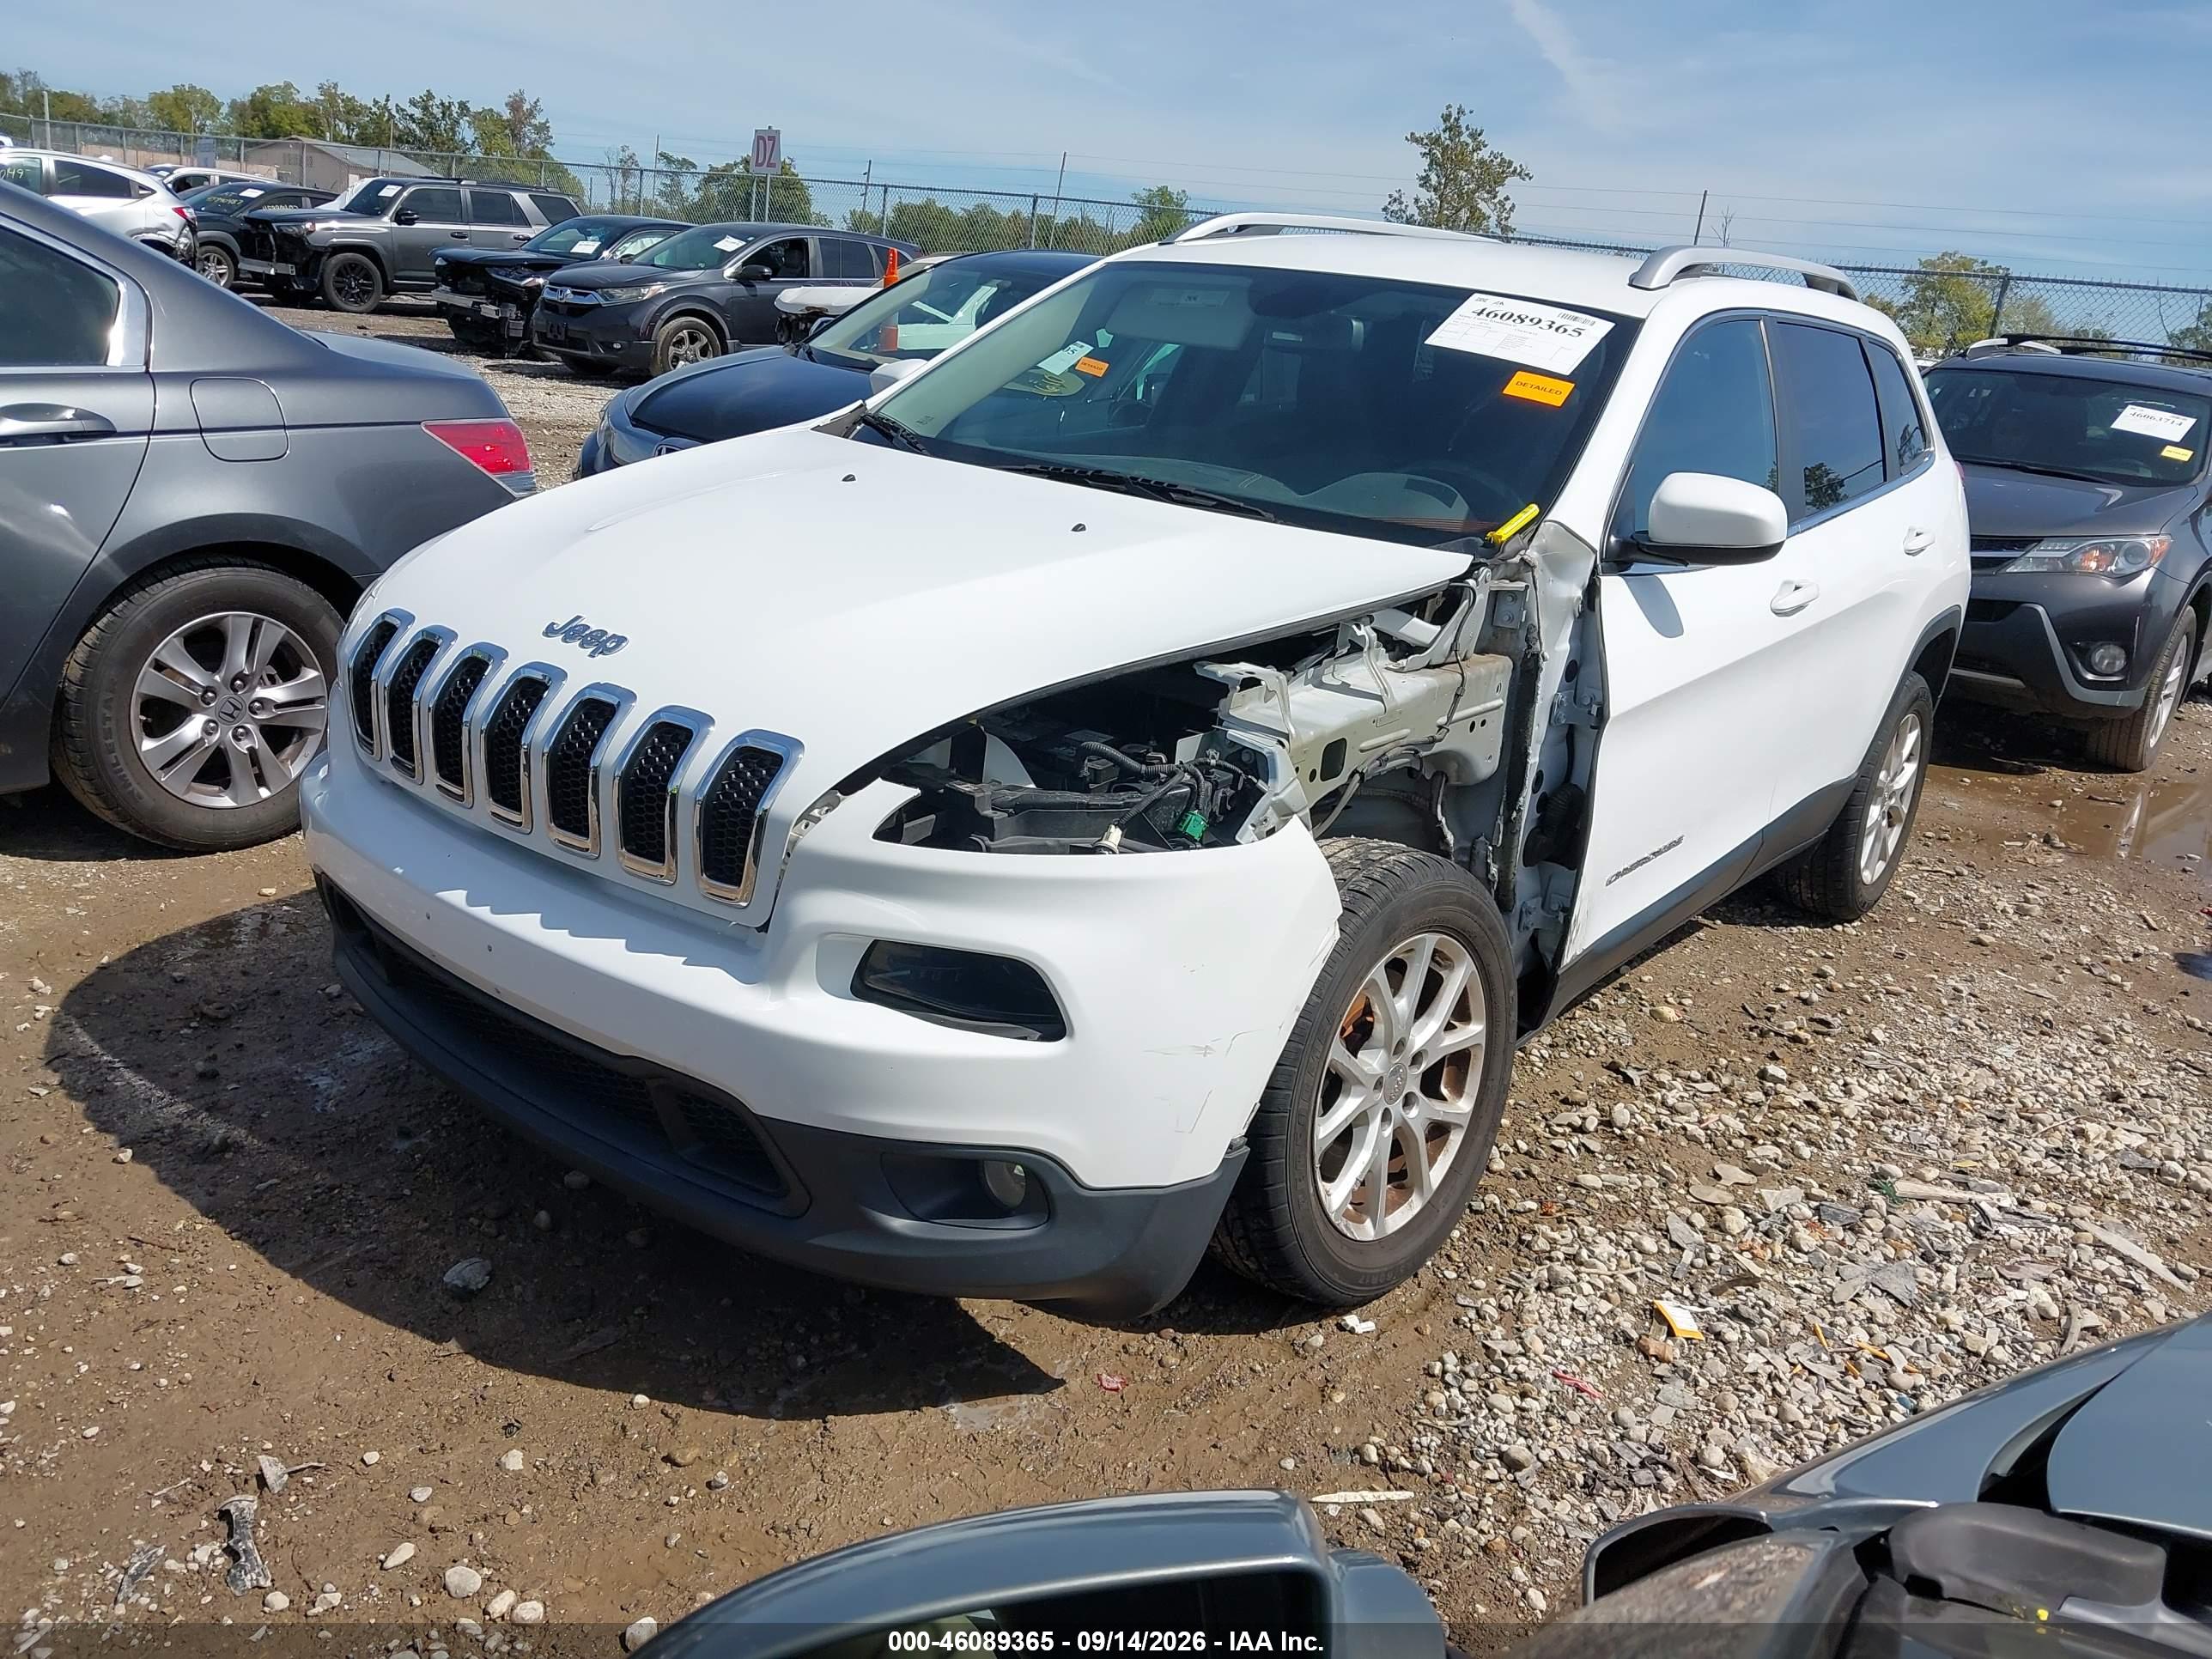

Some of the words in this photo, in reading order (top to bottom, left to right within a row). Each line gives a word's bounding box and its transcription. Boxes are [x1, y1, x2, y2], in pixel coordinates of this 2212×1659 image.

[755, 135, 777, 168] DZ
[1472, 307, 1587, 338] 46089365
[1516, 380, 1563, 396] DETAILED
[542, 615, 629, 659] Jeep
